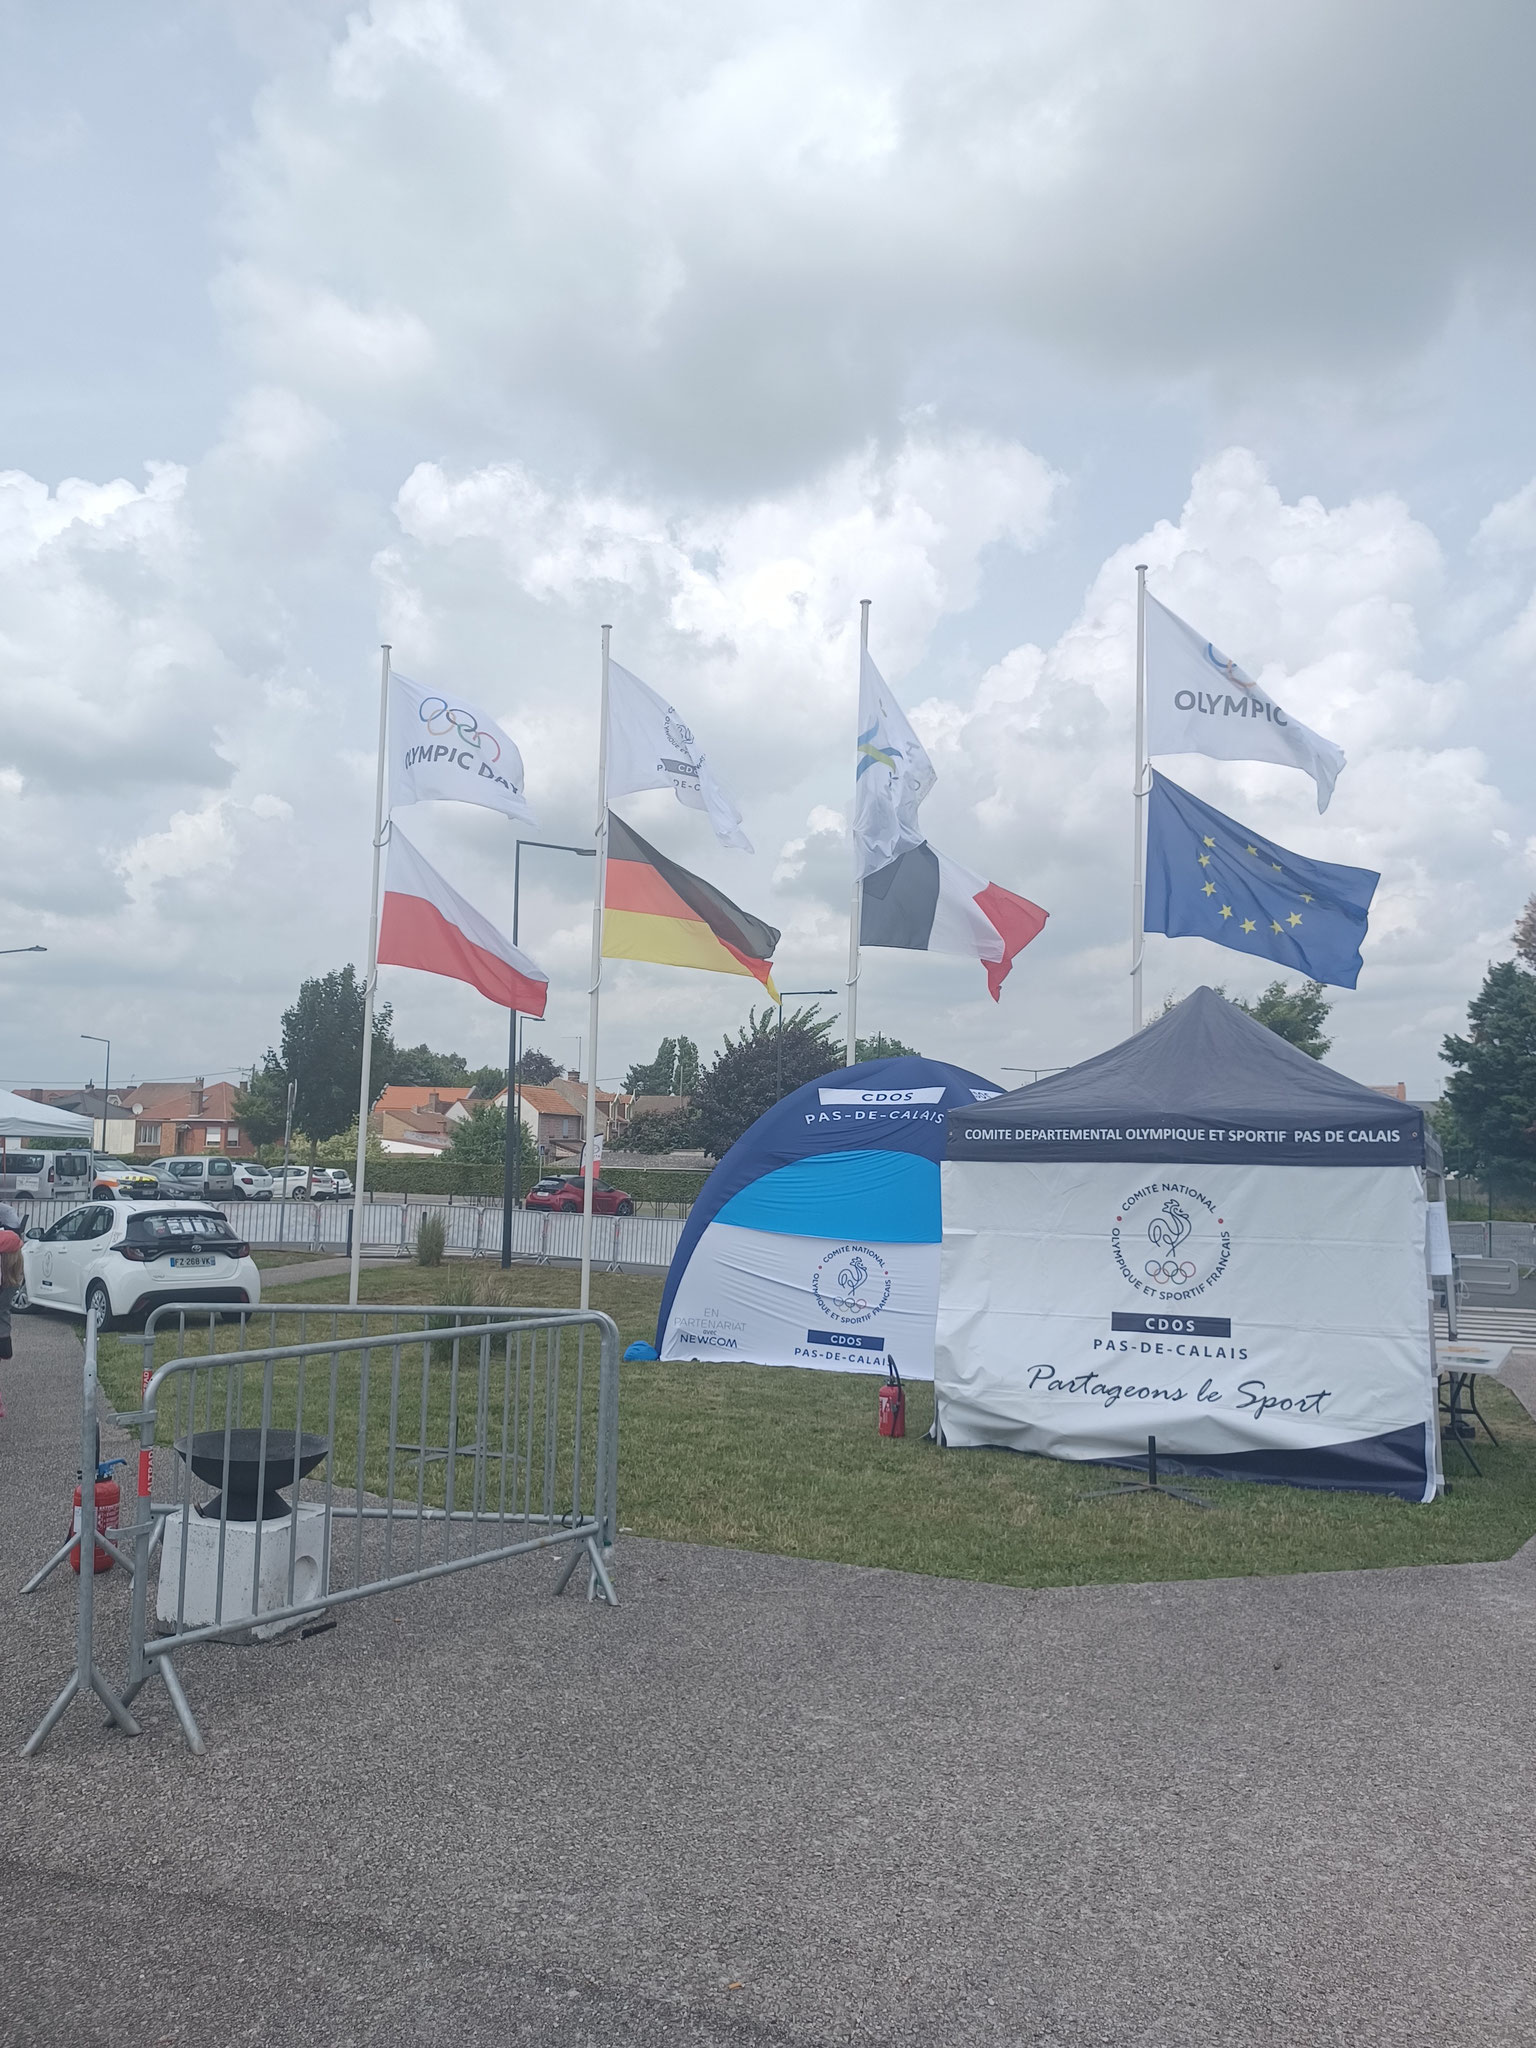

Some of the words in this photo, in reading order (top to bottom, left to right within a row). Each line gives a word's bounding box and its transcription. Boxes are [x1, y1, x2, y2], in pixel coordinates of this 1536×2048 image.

[1174, 690, 1288, 727] OLYMPIC
[861, 1092, 914, 1102] CDOS
[805, 1110, 945, 1125] PAS-DE-CALAIS
[964, 1129, 1012, 1140] COMITE
[1015, 1129, 1123, 1140] DEPARTEMENTAL
[1125, 1129, 1205, 1141] OLYMPIQUE
[1208, 1129, 1225, 1141] ET
[1228, 1130, 1287, 1142] SPORTIF
[1294, 1130, 1321, 1142] PAS
[1324, 1130, 1344, 1142] DE
[1348, 1130, 1400, 1142] CALAIS
[1121, 1183, 1159, 1211] COMITÉ
[1161, 1183, 1217, 1214] NATIONAL
[852, 1245, 886, 1268] NATIONAL
[1111, 1227, 1143, 1290] OLYMPIQUE
[1143, 1285, 1157, 1297] ET
[1159, 1283, 1206, 1301] SPORTIF
[1206, 1231, 1231, 1287] FRANÇAIS
[704, 1308, 719, 1317] EN
[830, 1312, 840, 1321] ET
[840, 1312, 872, 1324] SPORTIF
[674, 1317, 747, 1332] PARTENARIAT
[1145, 1317, 1196, 1333] CDOS
[680, 1334, 738, 1348] NEWCOM
[830, 1335, 862, 1346] CDOS
[794, 1347, 889, 1367] PAS-DE-CALAI
[1093, 1339, 1248, 1360] PAS-DE-CALAIS
[1027, 1364, 1188, 1408] Partageons
[1196, 1378, 1223, 1403] le
[1235, 1380, 1332, 1420] Sport
